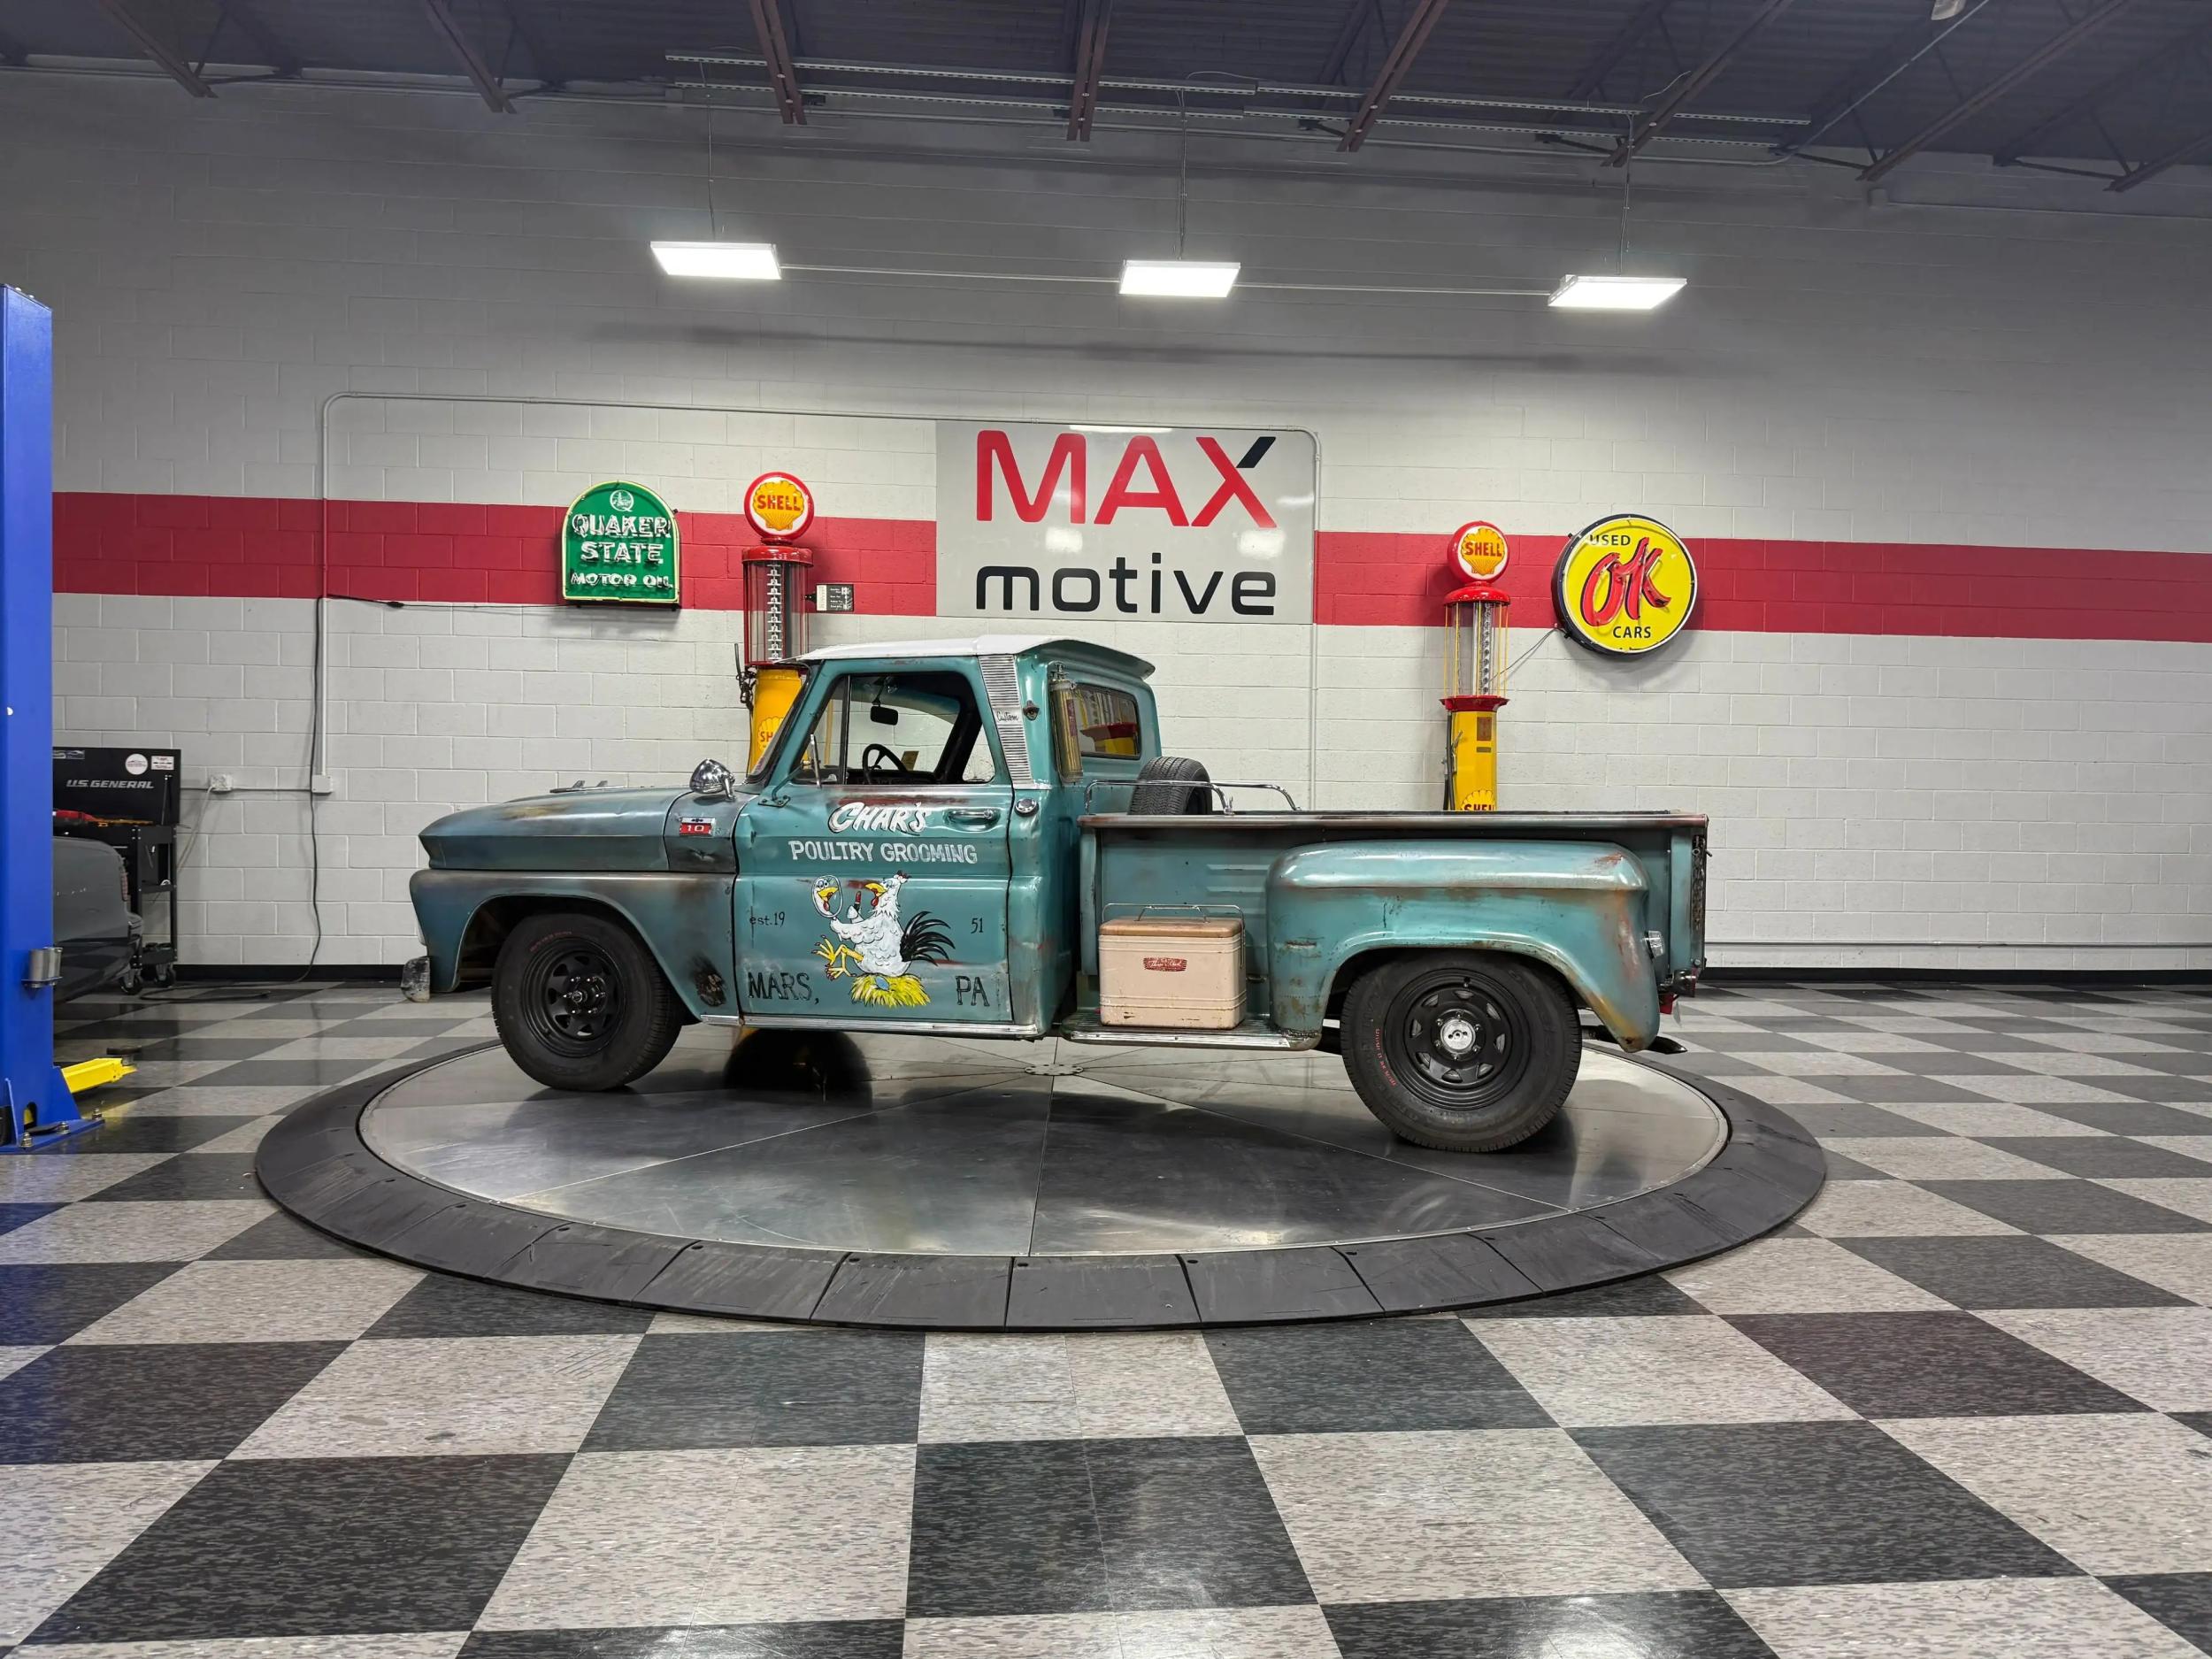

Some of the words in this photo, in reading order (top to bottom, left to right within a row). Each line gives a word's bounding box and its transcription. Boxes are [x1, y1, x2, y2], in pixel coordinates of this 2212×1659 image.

[977, 430, 1277, 528] MAX
[757, 494, 801, 511] SHELL
[572, 514, 672, 538] QUAKER
[1589, 534, 1631, 546] USED
[580, 541, 664, 564] STATE
[1464, 541, 1502, 557] SHELL
[571, 572, 637, 587] MOTOR
[642, 574, 673, 588] OIL
[976, 552, 1276, 616] motive
[1580, 536, 1671, 626] OK
[1612, 626, 1651, 638] CARS
[996, 710, 1019, 722] Custom
[89, 780, 155, 789] GENERAL
[788, 841, 874, 862] POULTRY
[880, 843, 978, 864] GROOMING
[971, 918, 984, 933] 51
[748, 972, 819, 1004] MARS,
[956, 975, 990, 1007] PA
